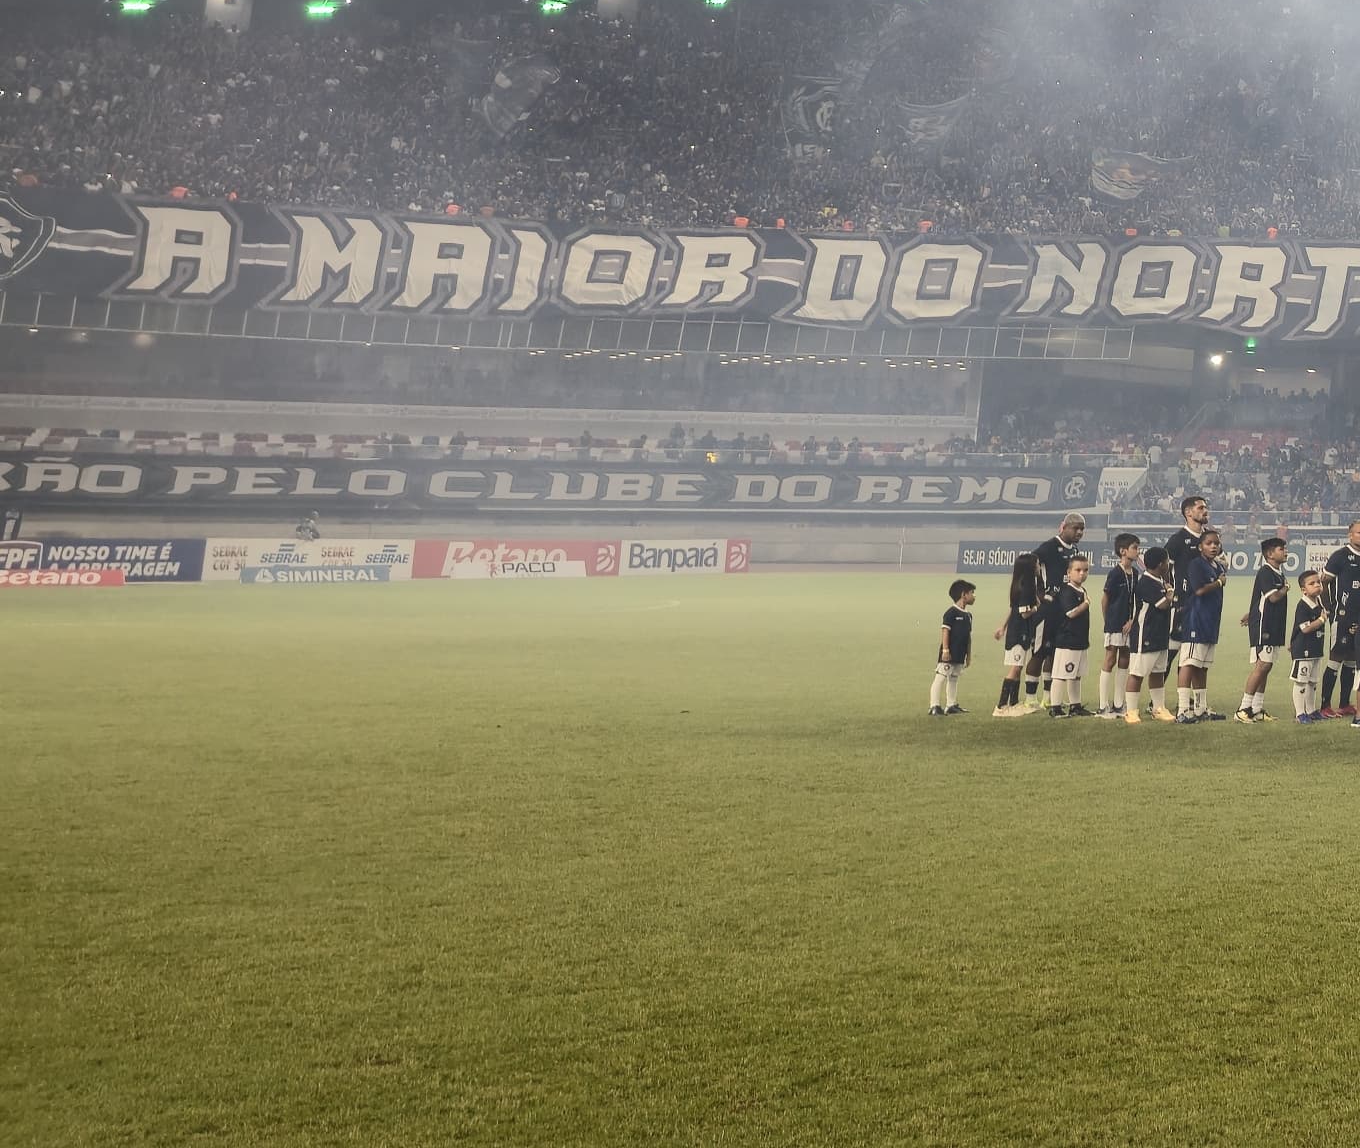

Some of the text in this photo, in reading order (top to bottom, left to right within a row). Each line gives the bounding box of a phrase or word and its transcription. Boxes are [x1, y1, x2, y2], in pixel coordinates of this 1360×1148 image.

[126, 207, 226, 293] A
[280, 215, 757, 310] MAIOR
[793, 238, 984, 321] DO
[169, 465, 407, 497] PELO
[429, 469, 707, 502] CLUBE
[730, 473, 833, 504] DO
[852, 474, 1051, 506] REMO
[48, 542, 173, 561] NOSSO TIME É
[260, 553, 309, 564] SEBRAE
[365, 553, 410, 564] SEBRAE
[628, 542, 719, 572] Banpará
[963, 549, 986, 565] SEJA
[988, 546, 1016, 565] SÓCIO
[277, 569, 379, 582] SIMINERAL
[502, 561, 556, 574] PACO
